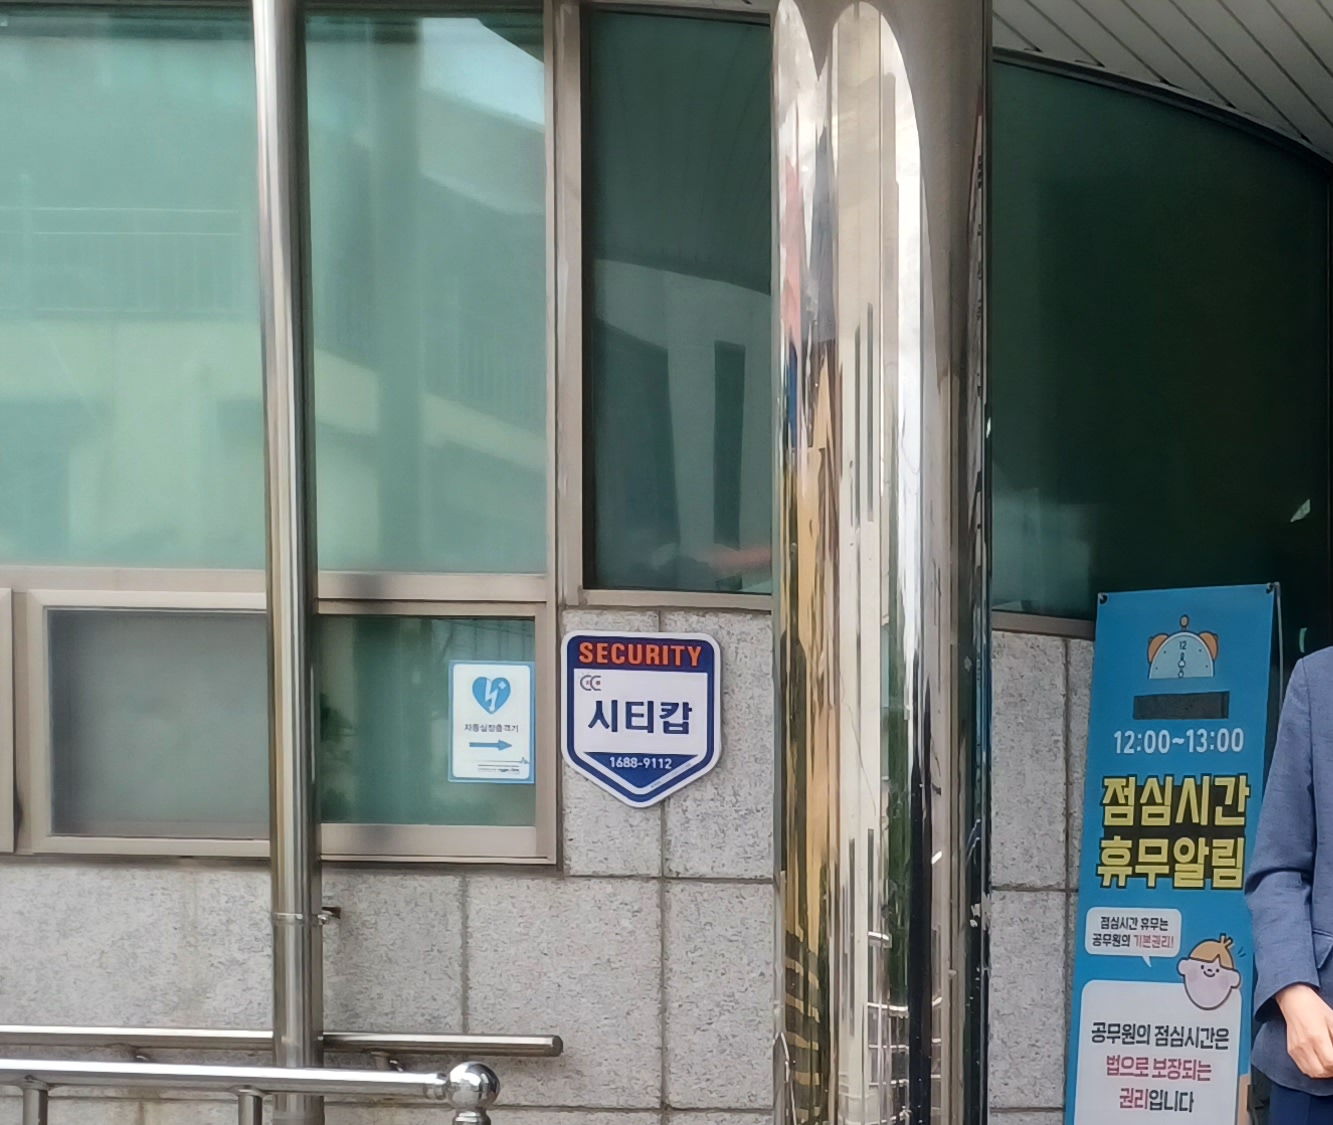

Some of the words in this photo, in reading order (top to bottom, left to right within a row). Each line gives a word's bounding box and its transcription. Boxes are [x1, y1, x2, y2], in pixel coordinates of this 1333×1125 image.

[578, 641, 702, 667] SECURITY
[587, 699, 693, 735] 시티캅
[1113, 728, 1245, 754] 12:00~13:00
[609, 756, 673, 770] 1688-9112
[1101, 775, 1251, 827] 점심시간
[1097, 835, 1246, 889] 휴무알림
[1100, 916, 1138, 931] 점심시간
[1140, 917, 1169, 931] 휴무는
[1092, 933, 1131, 947] 공무원의
[1133, 935, 1175, 949] 기본권리!
[1091, 1022, 1151, 1046] 공무원의
[1154, 1025, 1230, 1050] 점심시간은
[1106, 1055, 1149, 1077] 법으로
[1151, 1058, 1212, 1081] 보장되는
[1119, 1088, 1194, 1113] 권리입니다
